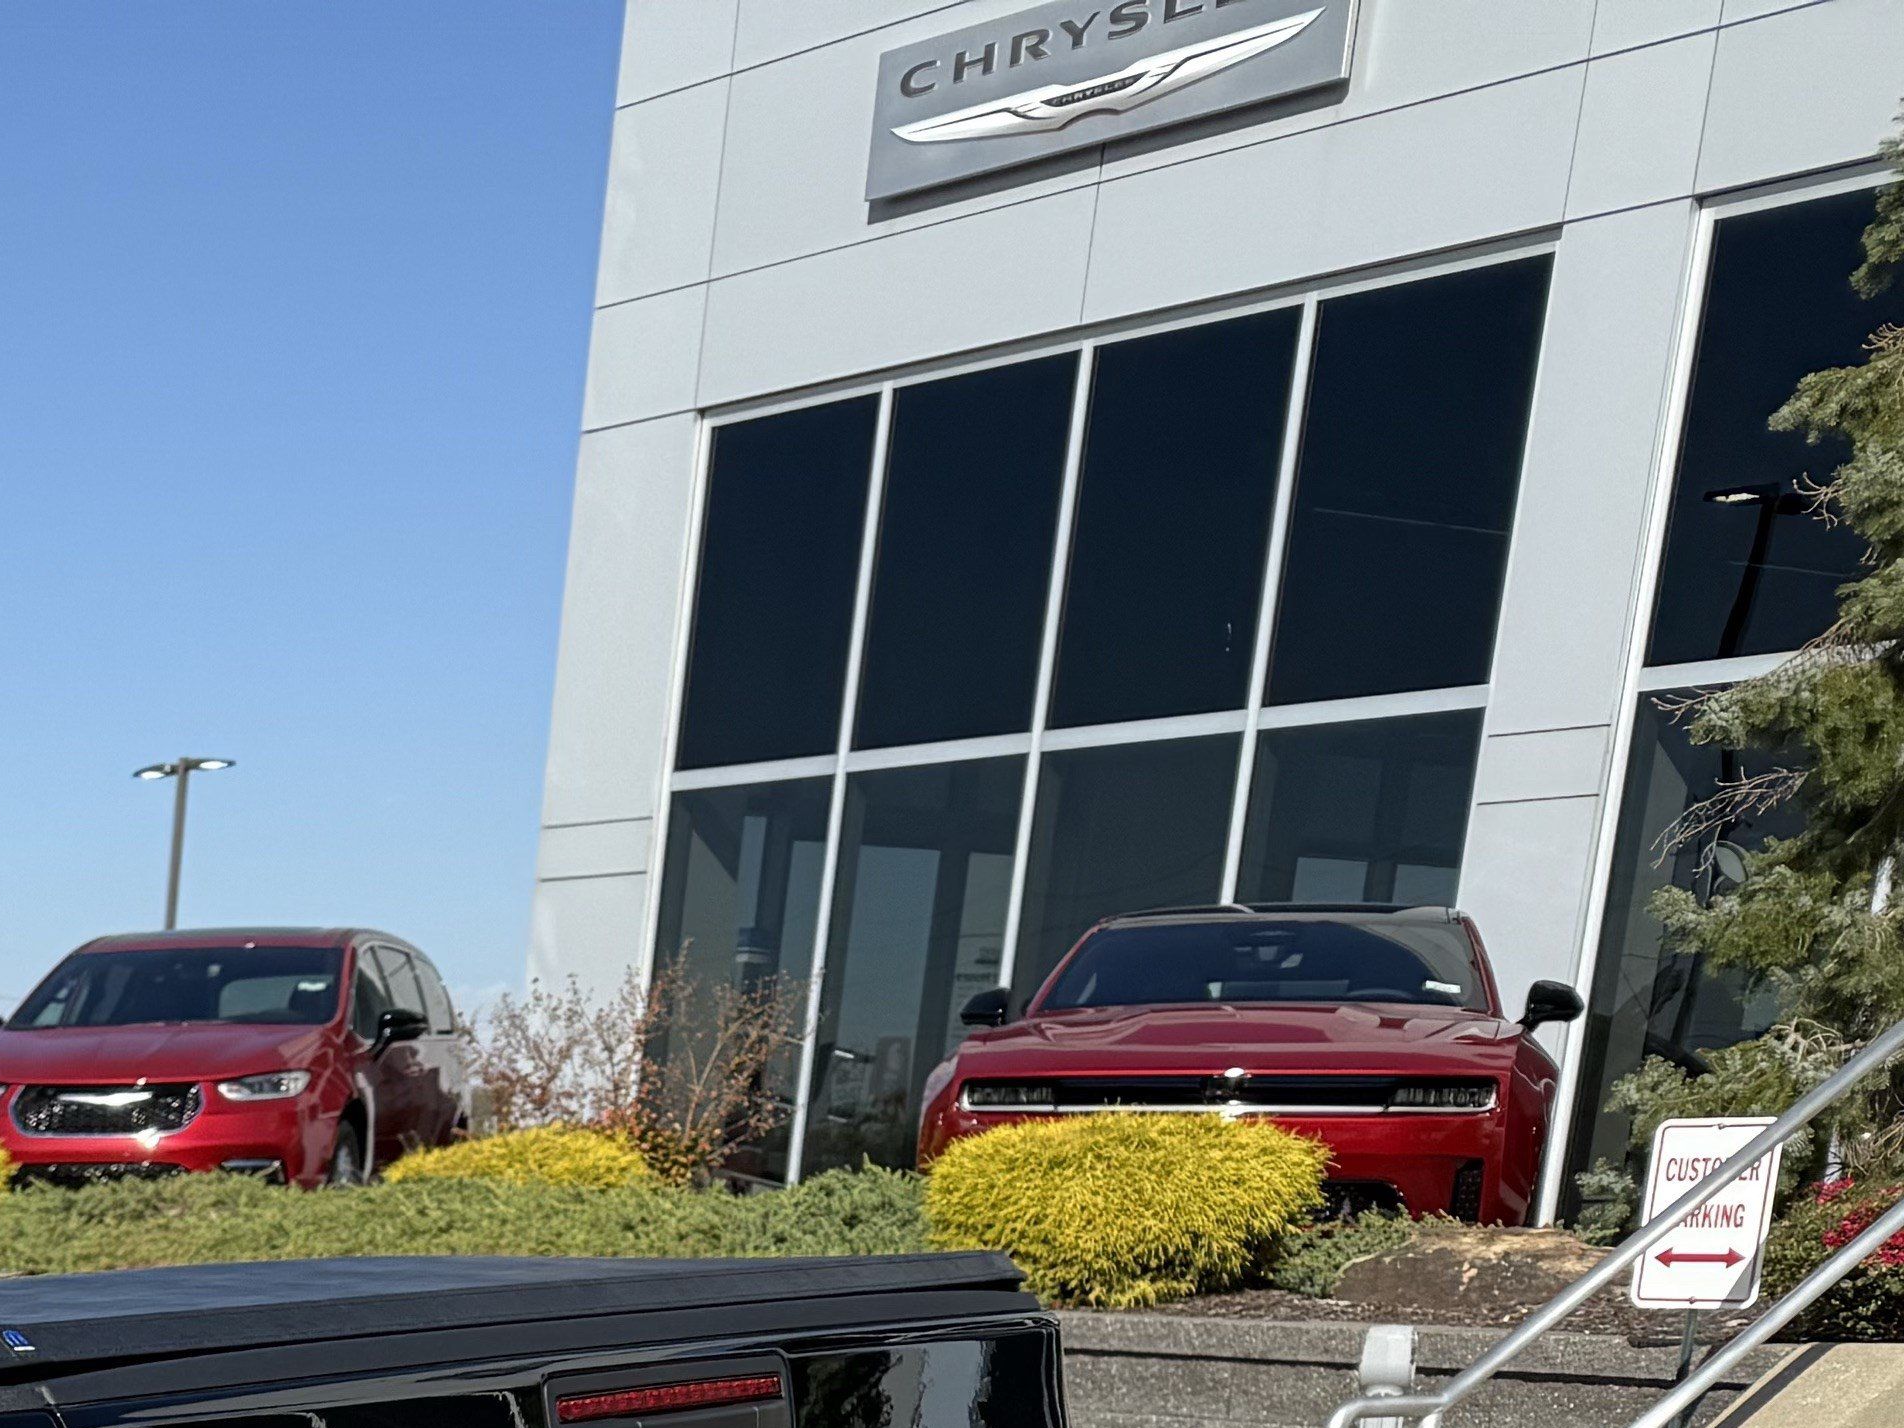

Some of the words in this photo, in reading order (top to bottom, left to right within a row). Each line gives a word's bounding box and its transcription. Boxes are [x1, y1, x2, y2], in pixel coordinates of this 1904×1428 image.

[899, 0, 1248, 98] CHRYSL
[1665, 1157, 1762, 1181] CUSTOR
[1678, 1203, 1746, 1228] RKING
